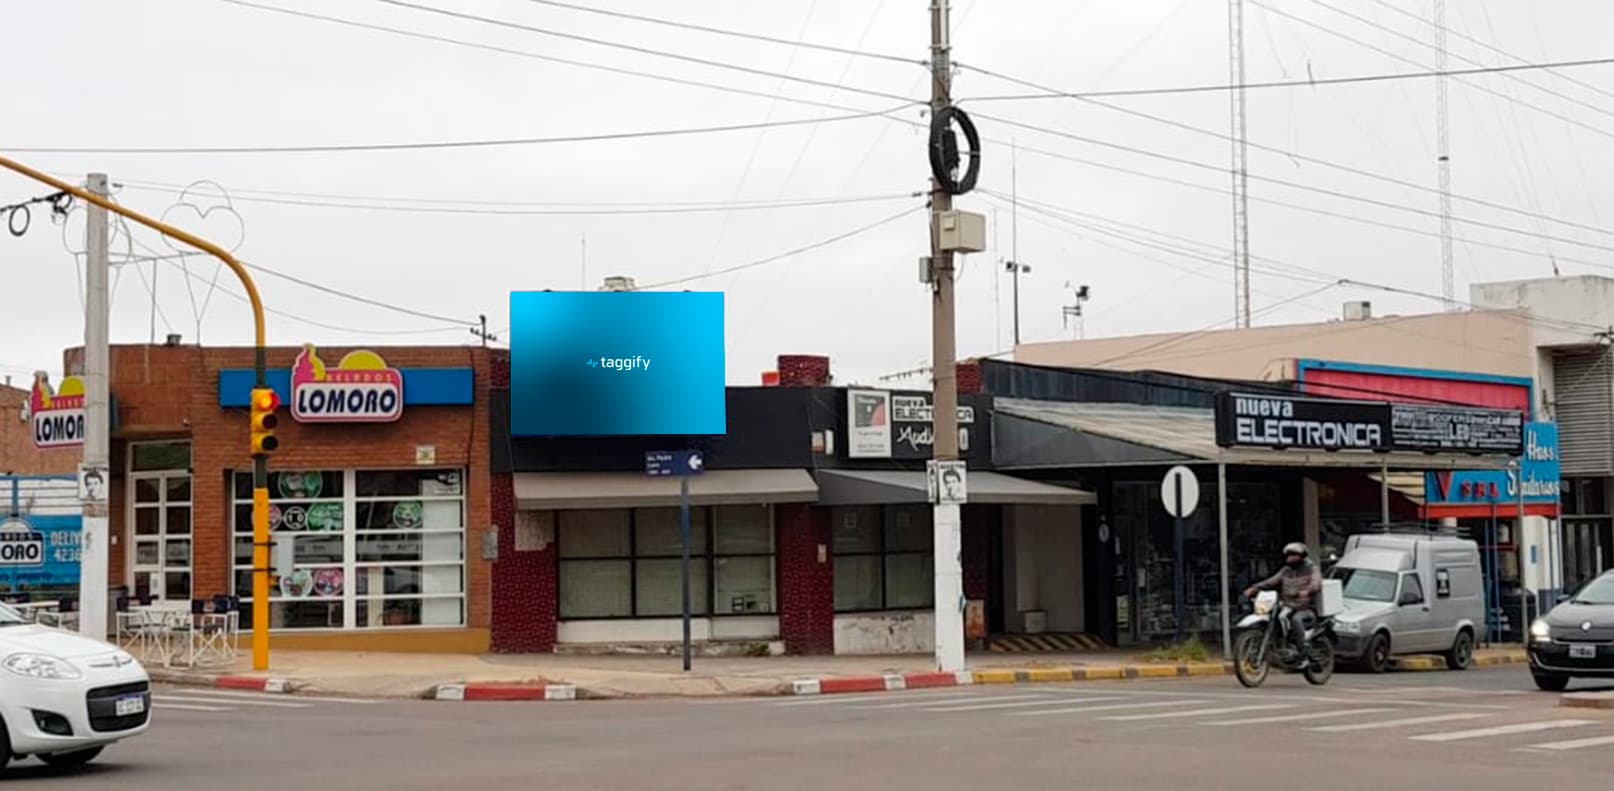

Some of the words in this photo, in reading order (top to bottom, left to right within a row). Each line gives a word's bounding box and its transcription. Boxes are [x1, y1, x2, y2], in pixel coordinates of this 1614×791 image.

[600, 355, 651, 371] taggify
[298, 389, 396, 414] LOMORO
[1235, 397, 1293, 417] nueva
[895, 408, 972, 420] ELECTCA
[36, 414, 84, 442] LOMOR
[1235, 417, 1381, 446] ELECTRONICA
[1, 543, 39, 560] ORO
